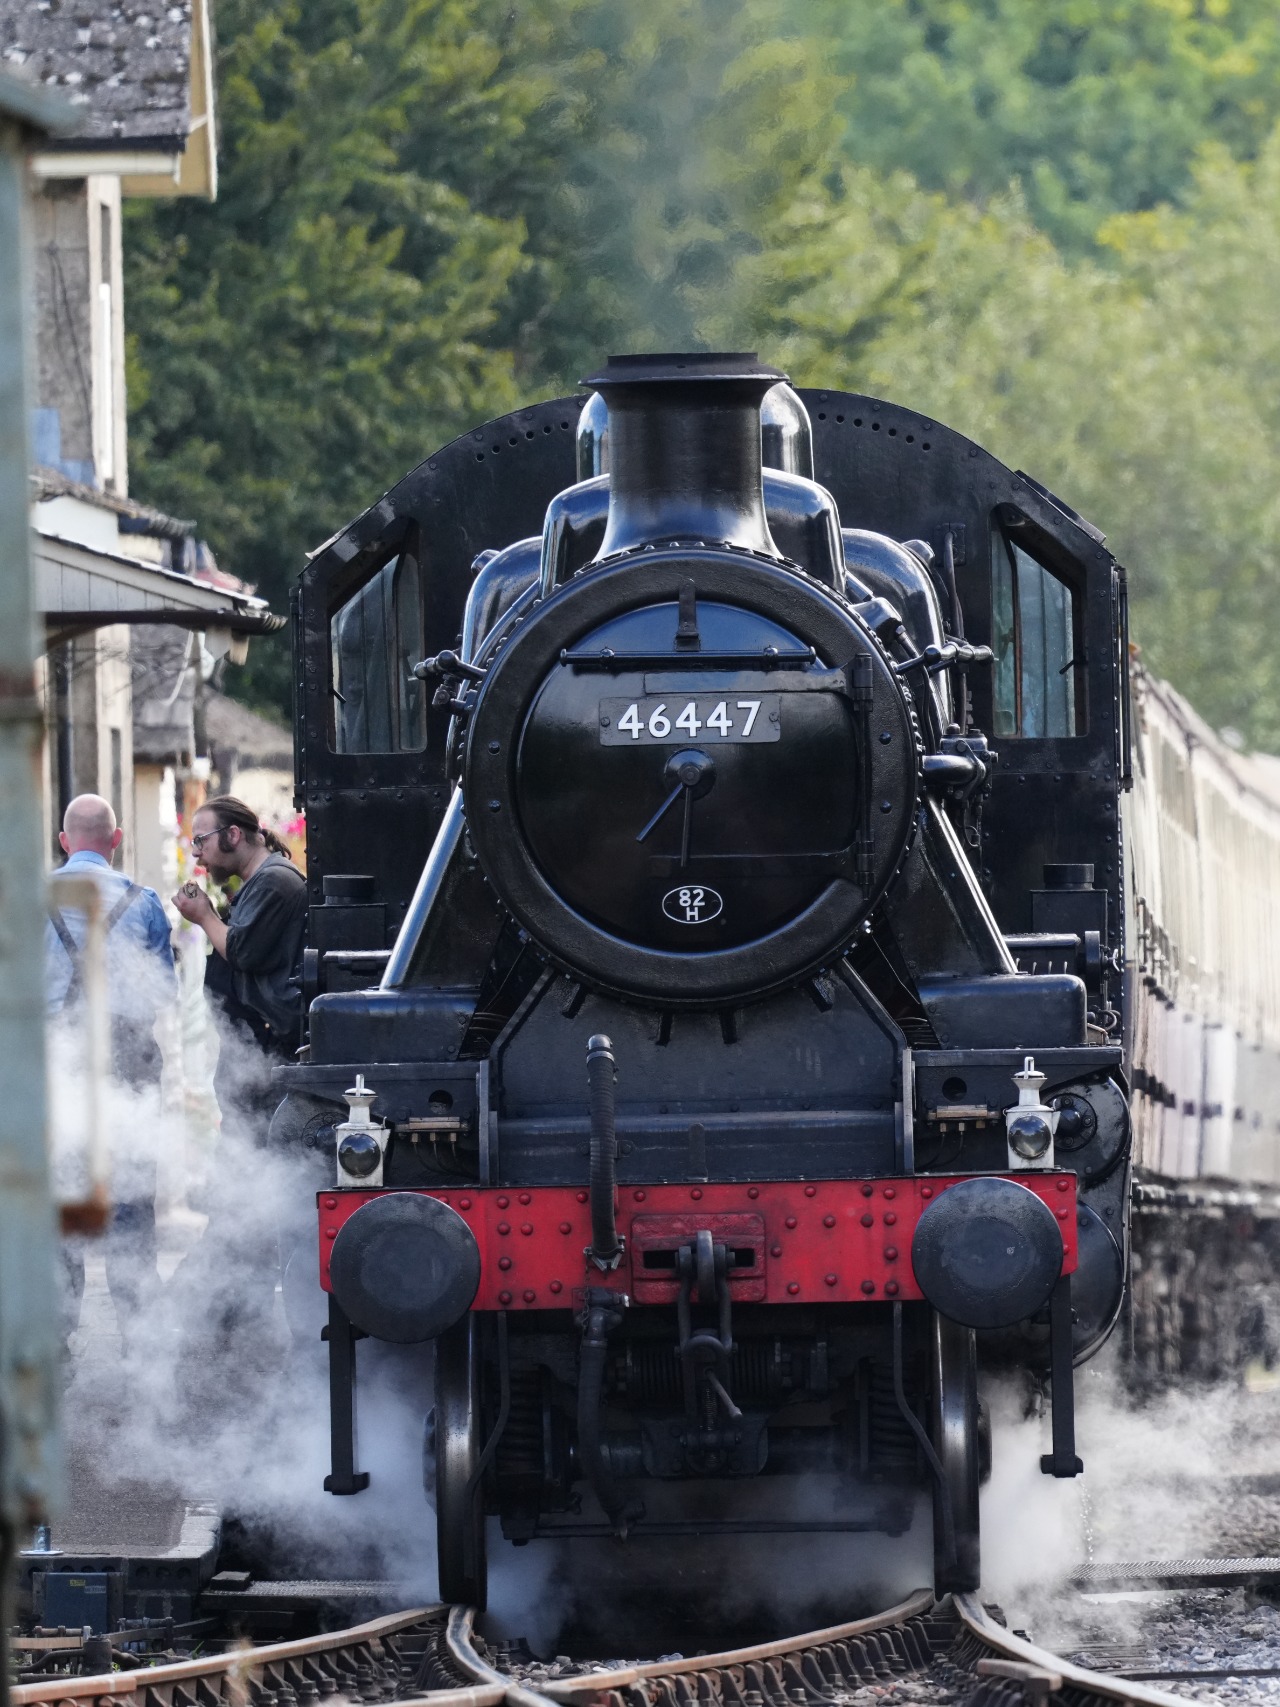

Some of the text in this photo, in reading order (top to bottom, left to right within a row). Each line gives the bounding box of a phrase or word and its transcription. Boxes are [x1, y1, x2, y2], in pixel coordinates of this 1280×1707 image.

[617, 701, 762, 739] 46447
[679, 889, 706, 907] 82
[686, 907, 699, 921] H
